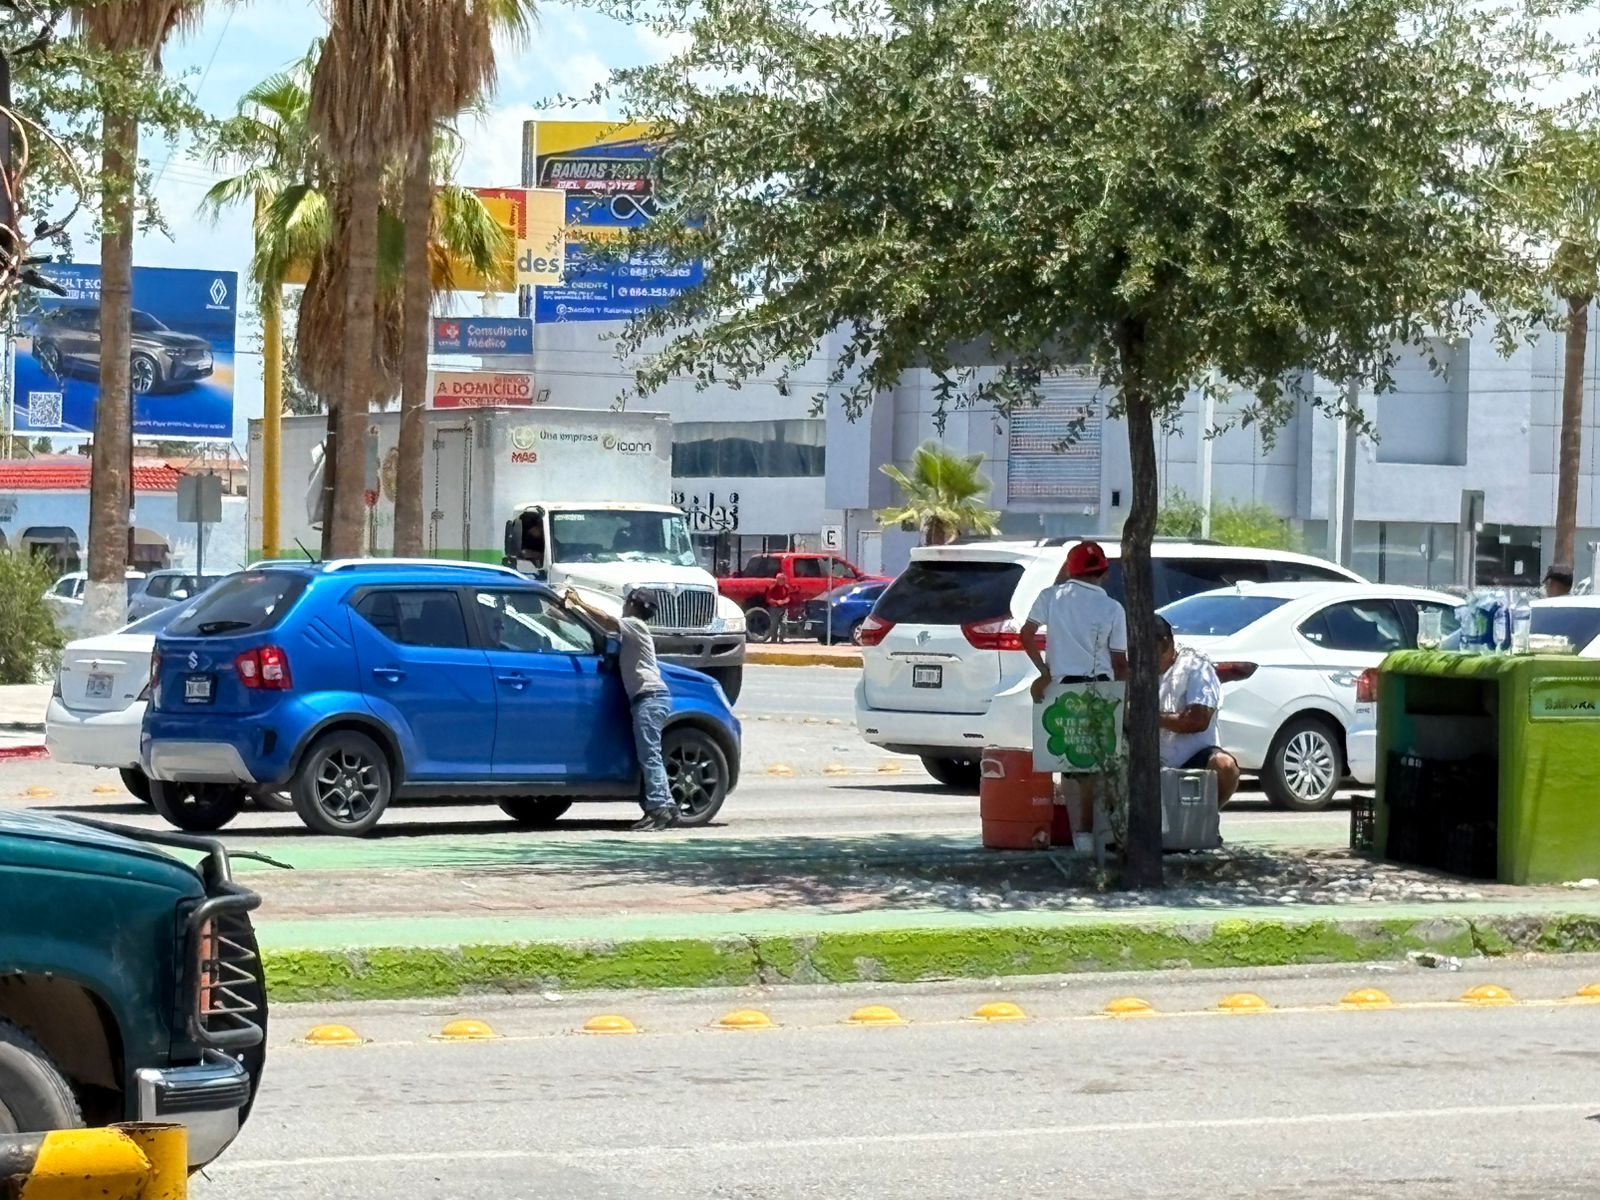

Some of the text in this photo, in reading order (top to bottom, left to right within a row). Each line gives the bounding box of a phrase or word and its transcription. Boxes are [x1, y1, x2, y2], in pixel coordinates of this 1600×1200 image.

[551, 162, 607, 179] BANDAS
[467, 325, 528, 337] Consultorio
[437, 381, 530, 397] A DOMICILIO
[560, 433, 599, 443] empresa
[827, 530, 836, 545] E
